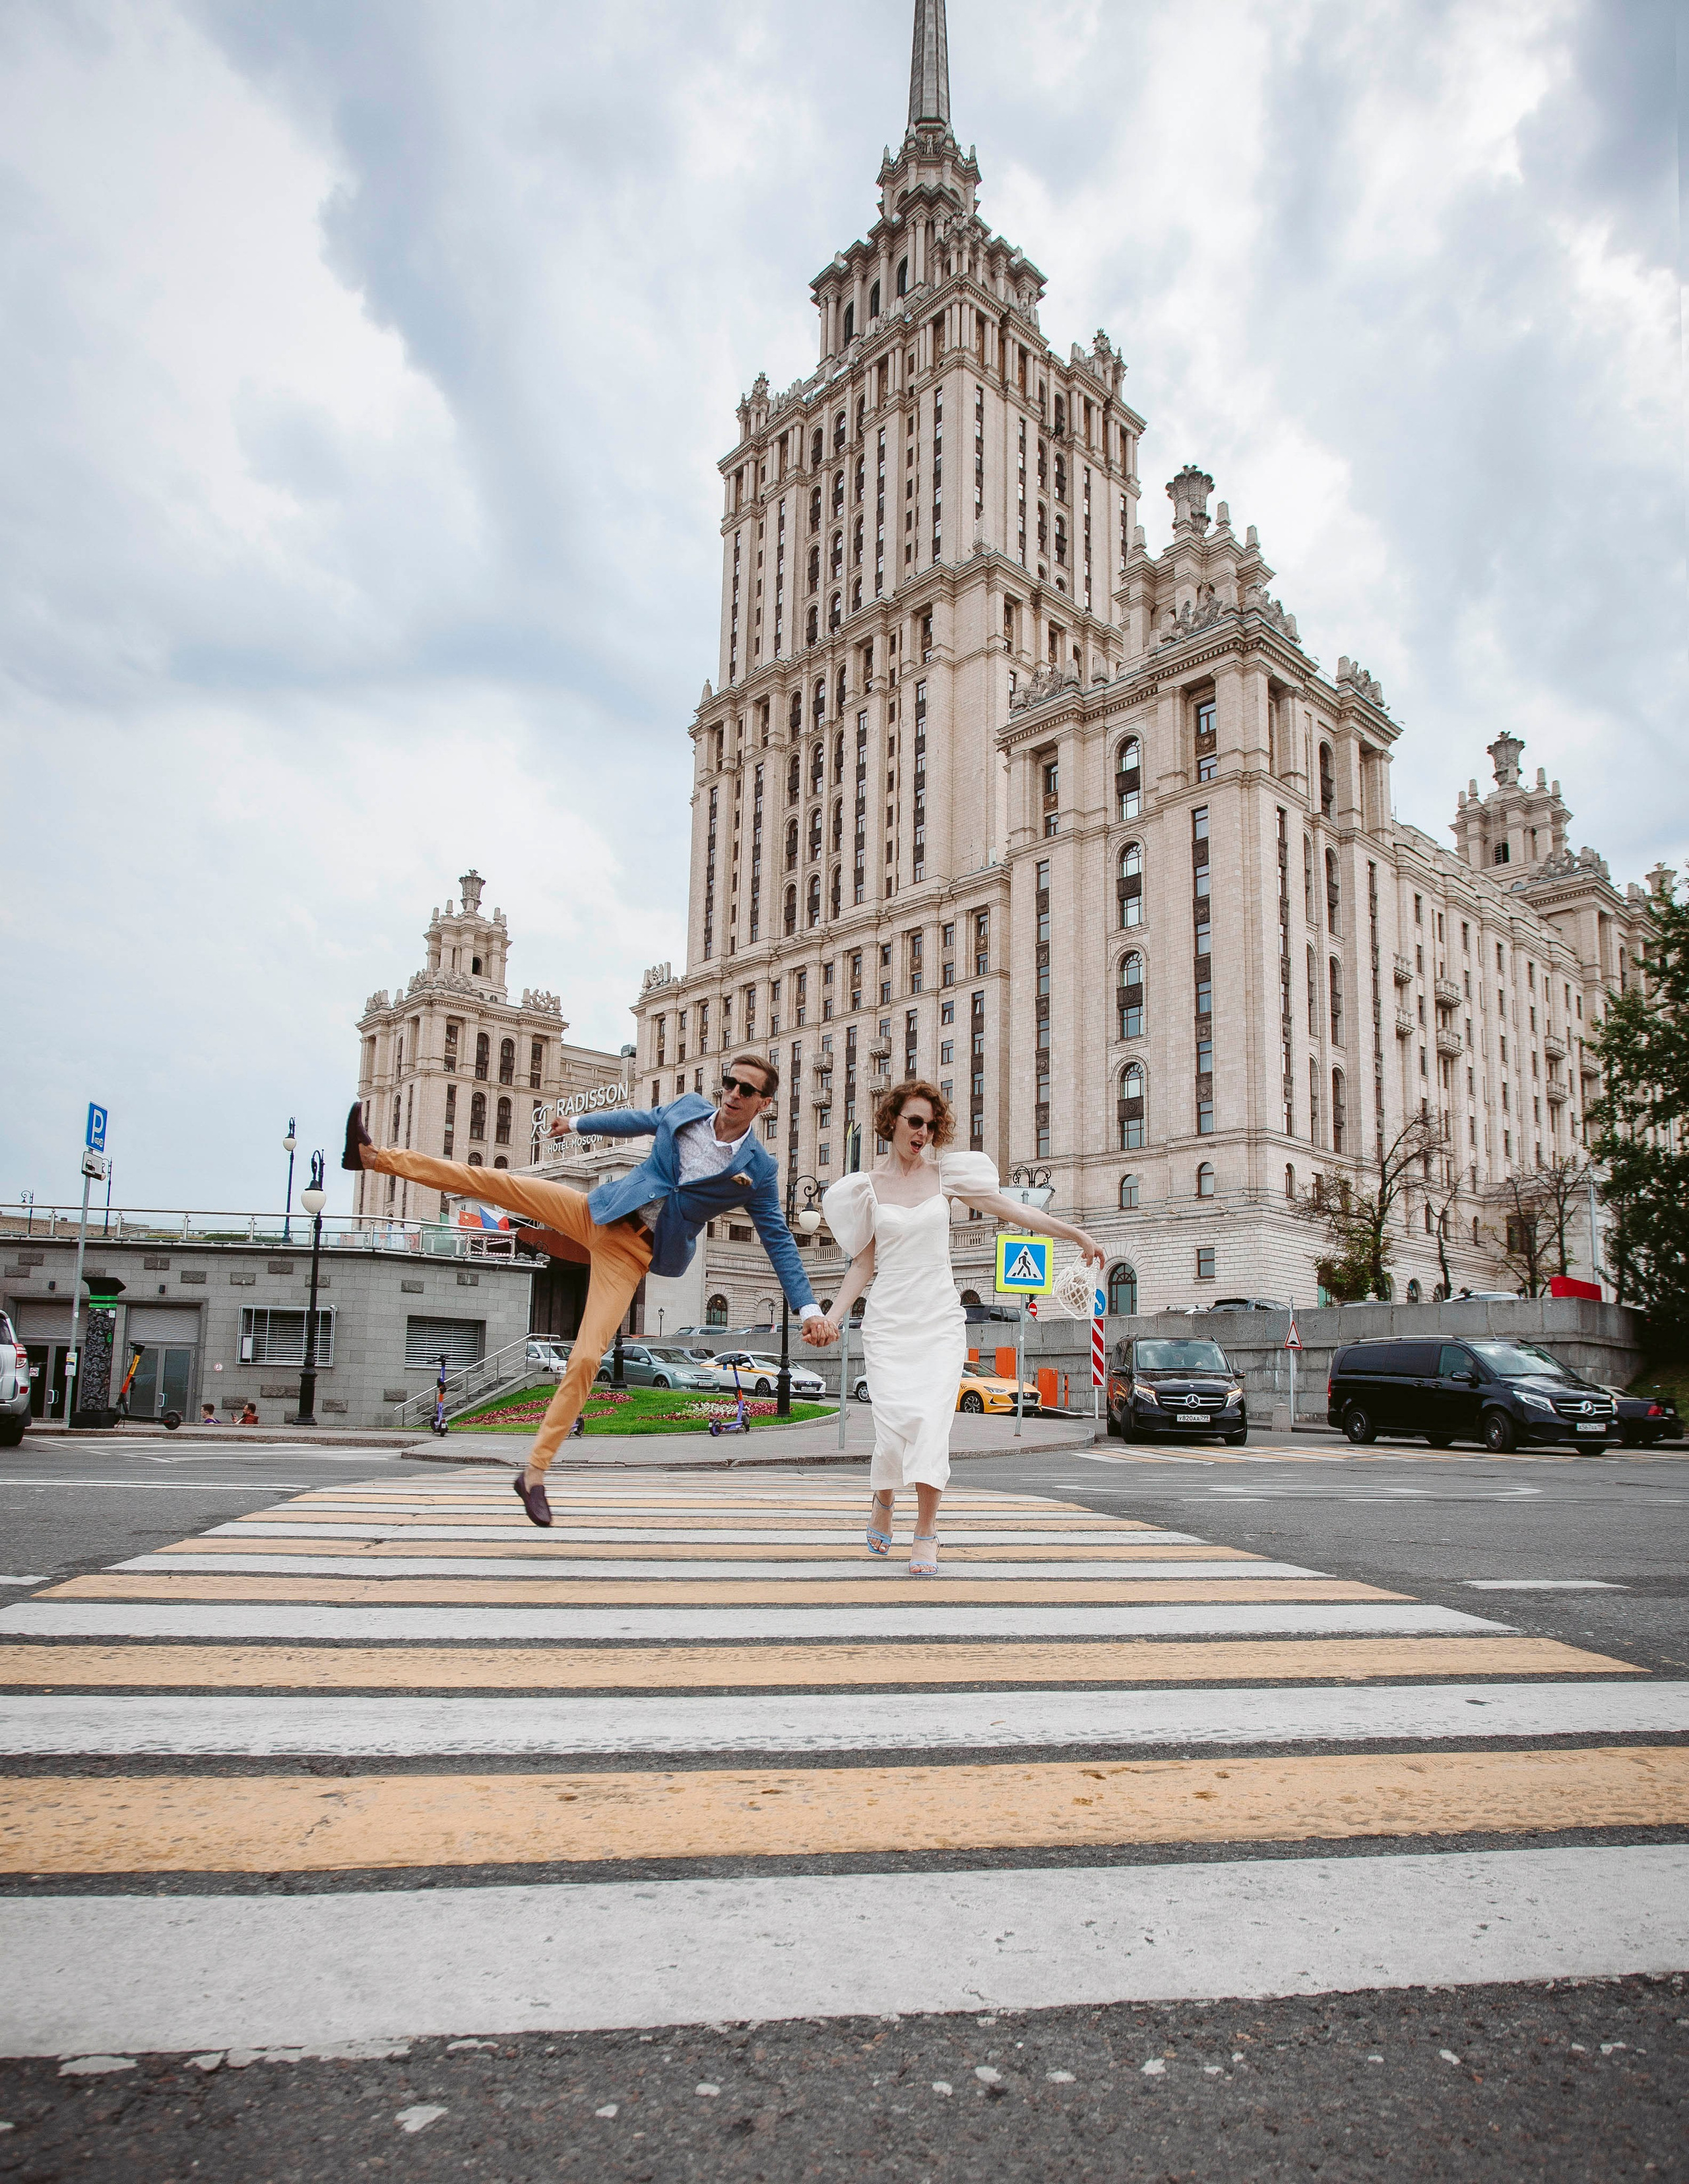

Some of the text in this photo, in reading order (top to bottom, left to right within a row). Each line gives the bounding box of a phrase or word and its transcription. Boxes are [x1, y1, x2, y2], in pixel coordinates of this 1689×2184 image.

[557, 1081, 629, 1117] RADISSON
[91, 1108, 104, 1144] P
[571, 1134, 603, 1148] MOSCOW
